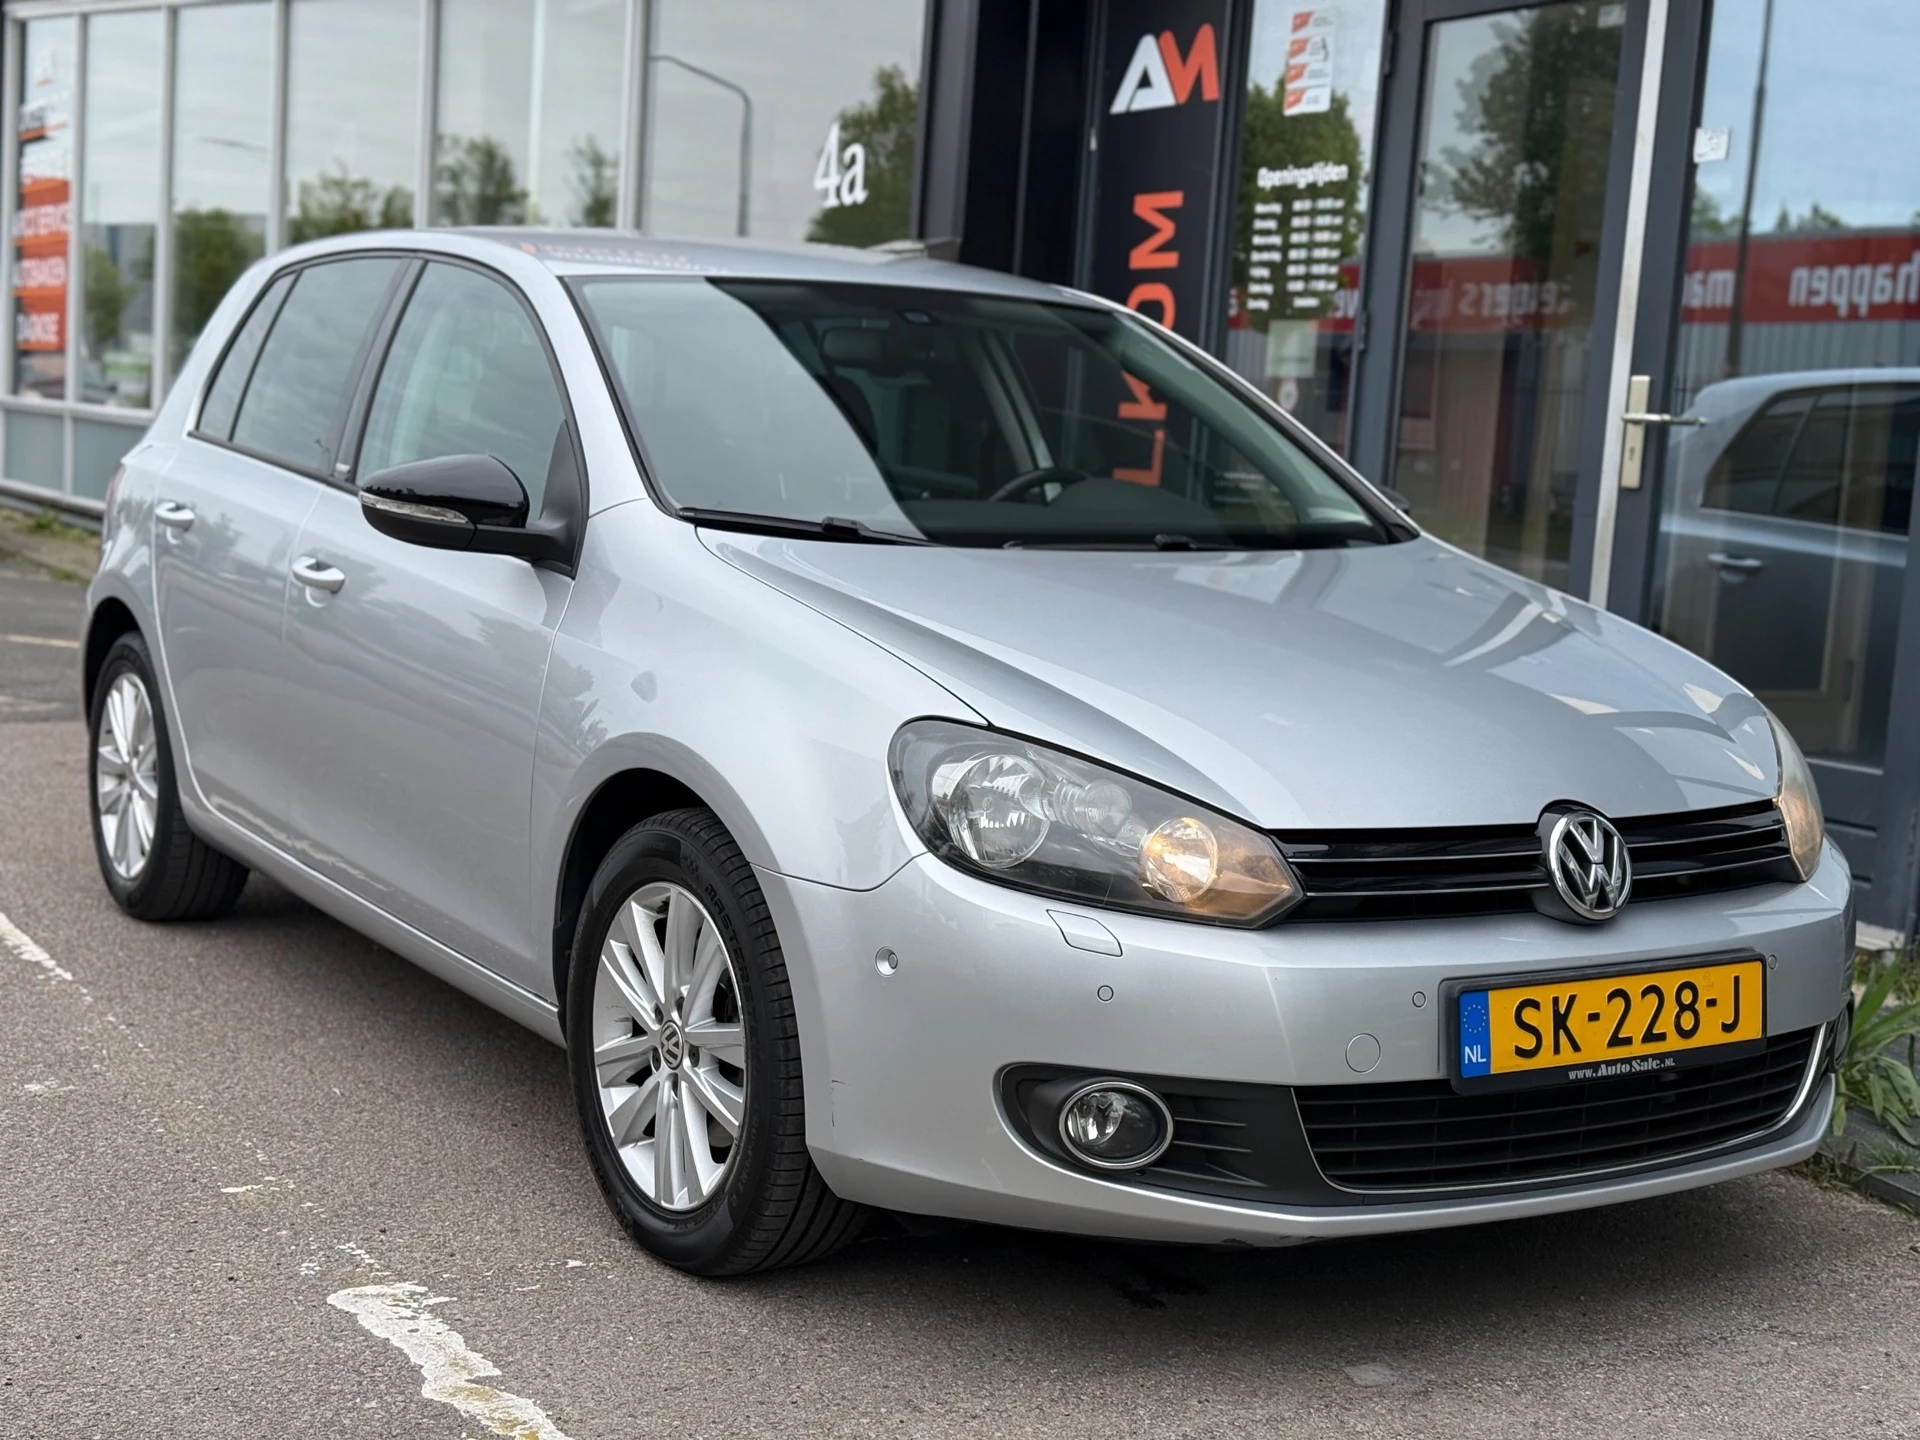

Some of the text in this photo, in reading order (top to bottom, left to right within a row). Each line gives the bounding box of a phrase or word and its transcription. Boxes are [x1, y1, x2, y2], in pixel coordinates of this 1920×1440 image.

[1109, 22, 1219, 115] AM
[813, 121, 868, 207] 4a
[1464, 1045, 1487, 1064] NL
[1513, 975, 1741, 1059] SK-228-J
